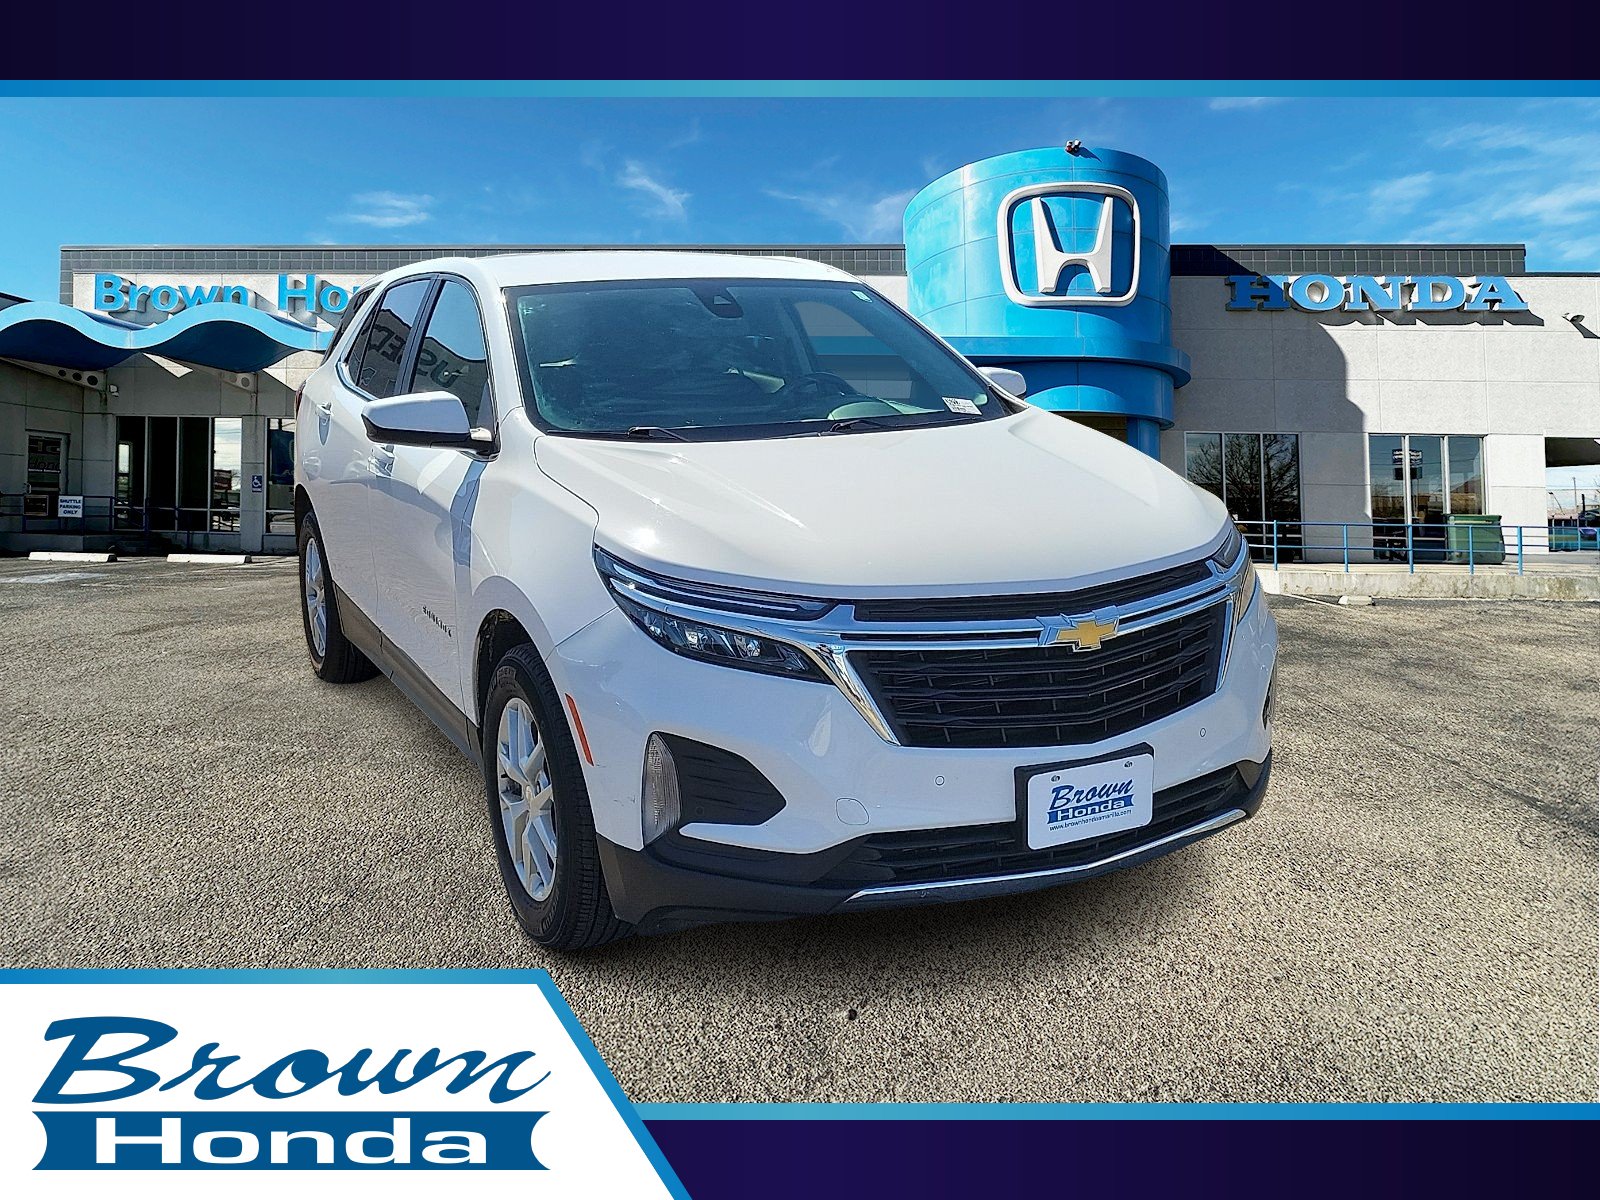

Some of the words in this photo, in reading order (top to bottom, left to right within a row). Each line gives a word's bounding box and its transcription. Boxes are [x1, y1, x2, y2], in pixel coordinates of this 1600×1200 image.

[95, 273, 249, 312] Brown
[1226, 273, 1529, 313] HONDA
[1049, 779, 1133, 810] Brown
[1057, 799, 1125, 821] Honda
